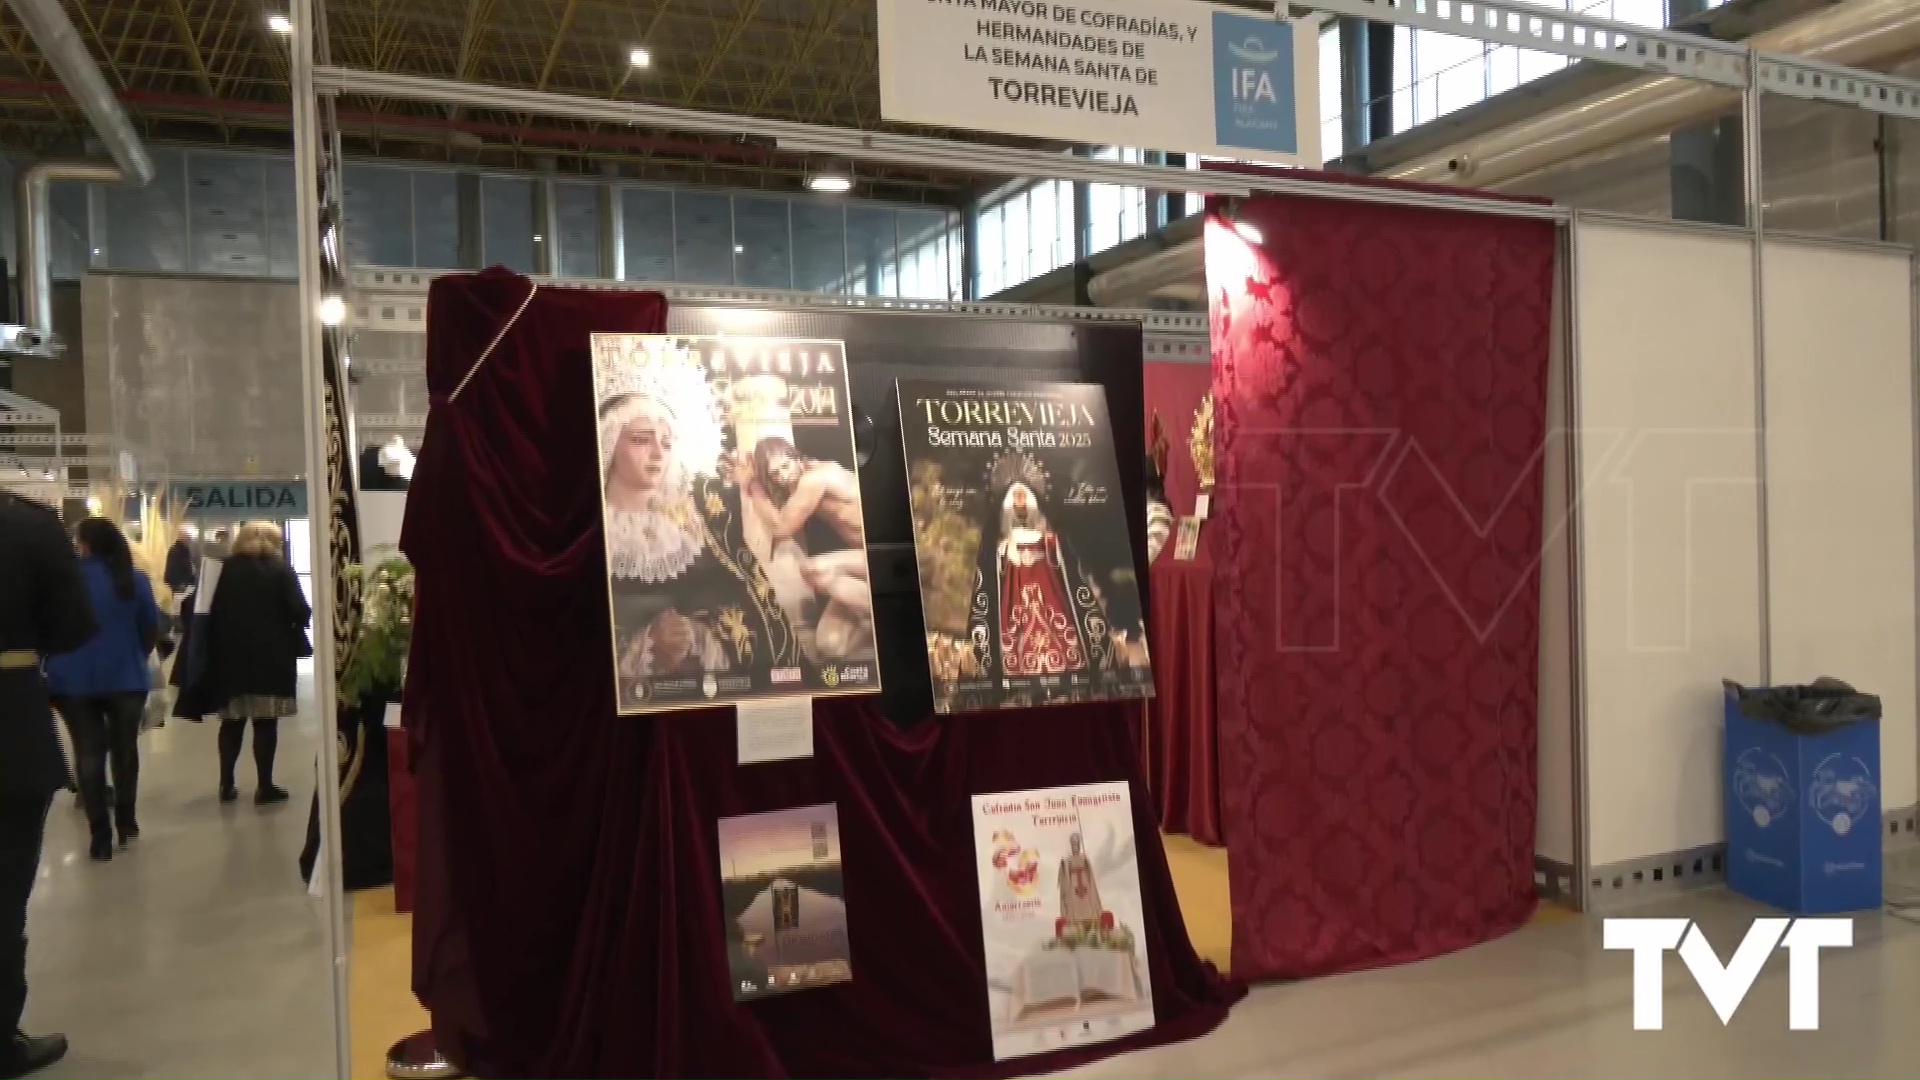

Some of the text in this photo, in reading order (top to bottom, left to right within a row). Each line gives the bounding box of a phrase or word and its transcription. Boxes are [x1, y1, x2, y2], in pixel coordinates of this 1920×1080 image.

[977, 19, 1145, 59] HERMANDADES DE
[981, 0, 1047, 19] MAYOR
[1053, 5, 1076, 24] DE
[1187, 24, 1198, 43] Y
[964, 43, 1158, 86] LA SEMANA SANTA DE
[988, 76, 1139, 116] TORREVIEJA
[1231, 67, 1277, 105] IFA
[916, 398, 1096, 427] TORREVIEJA
[928, 425, 1092, 449] Semana Santa 2025
[185, 485, 297, 510] SALIDA
